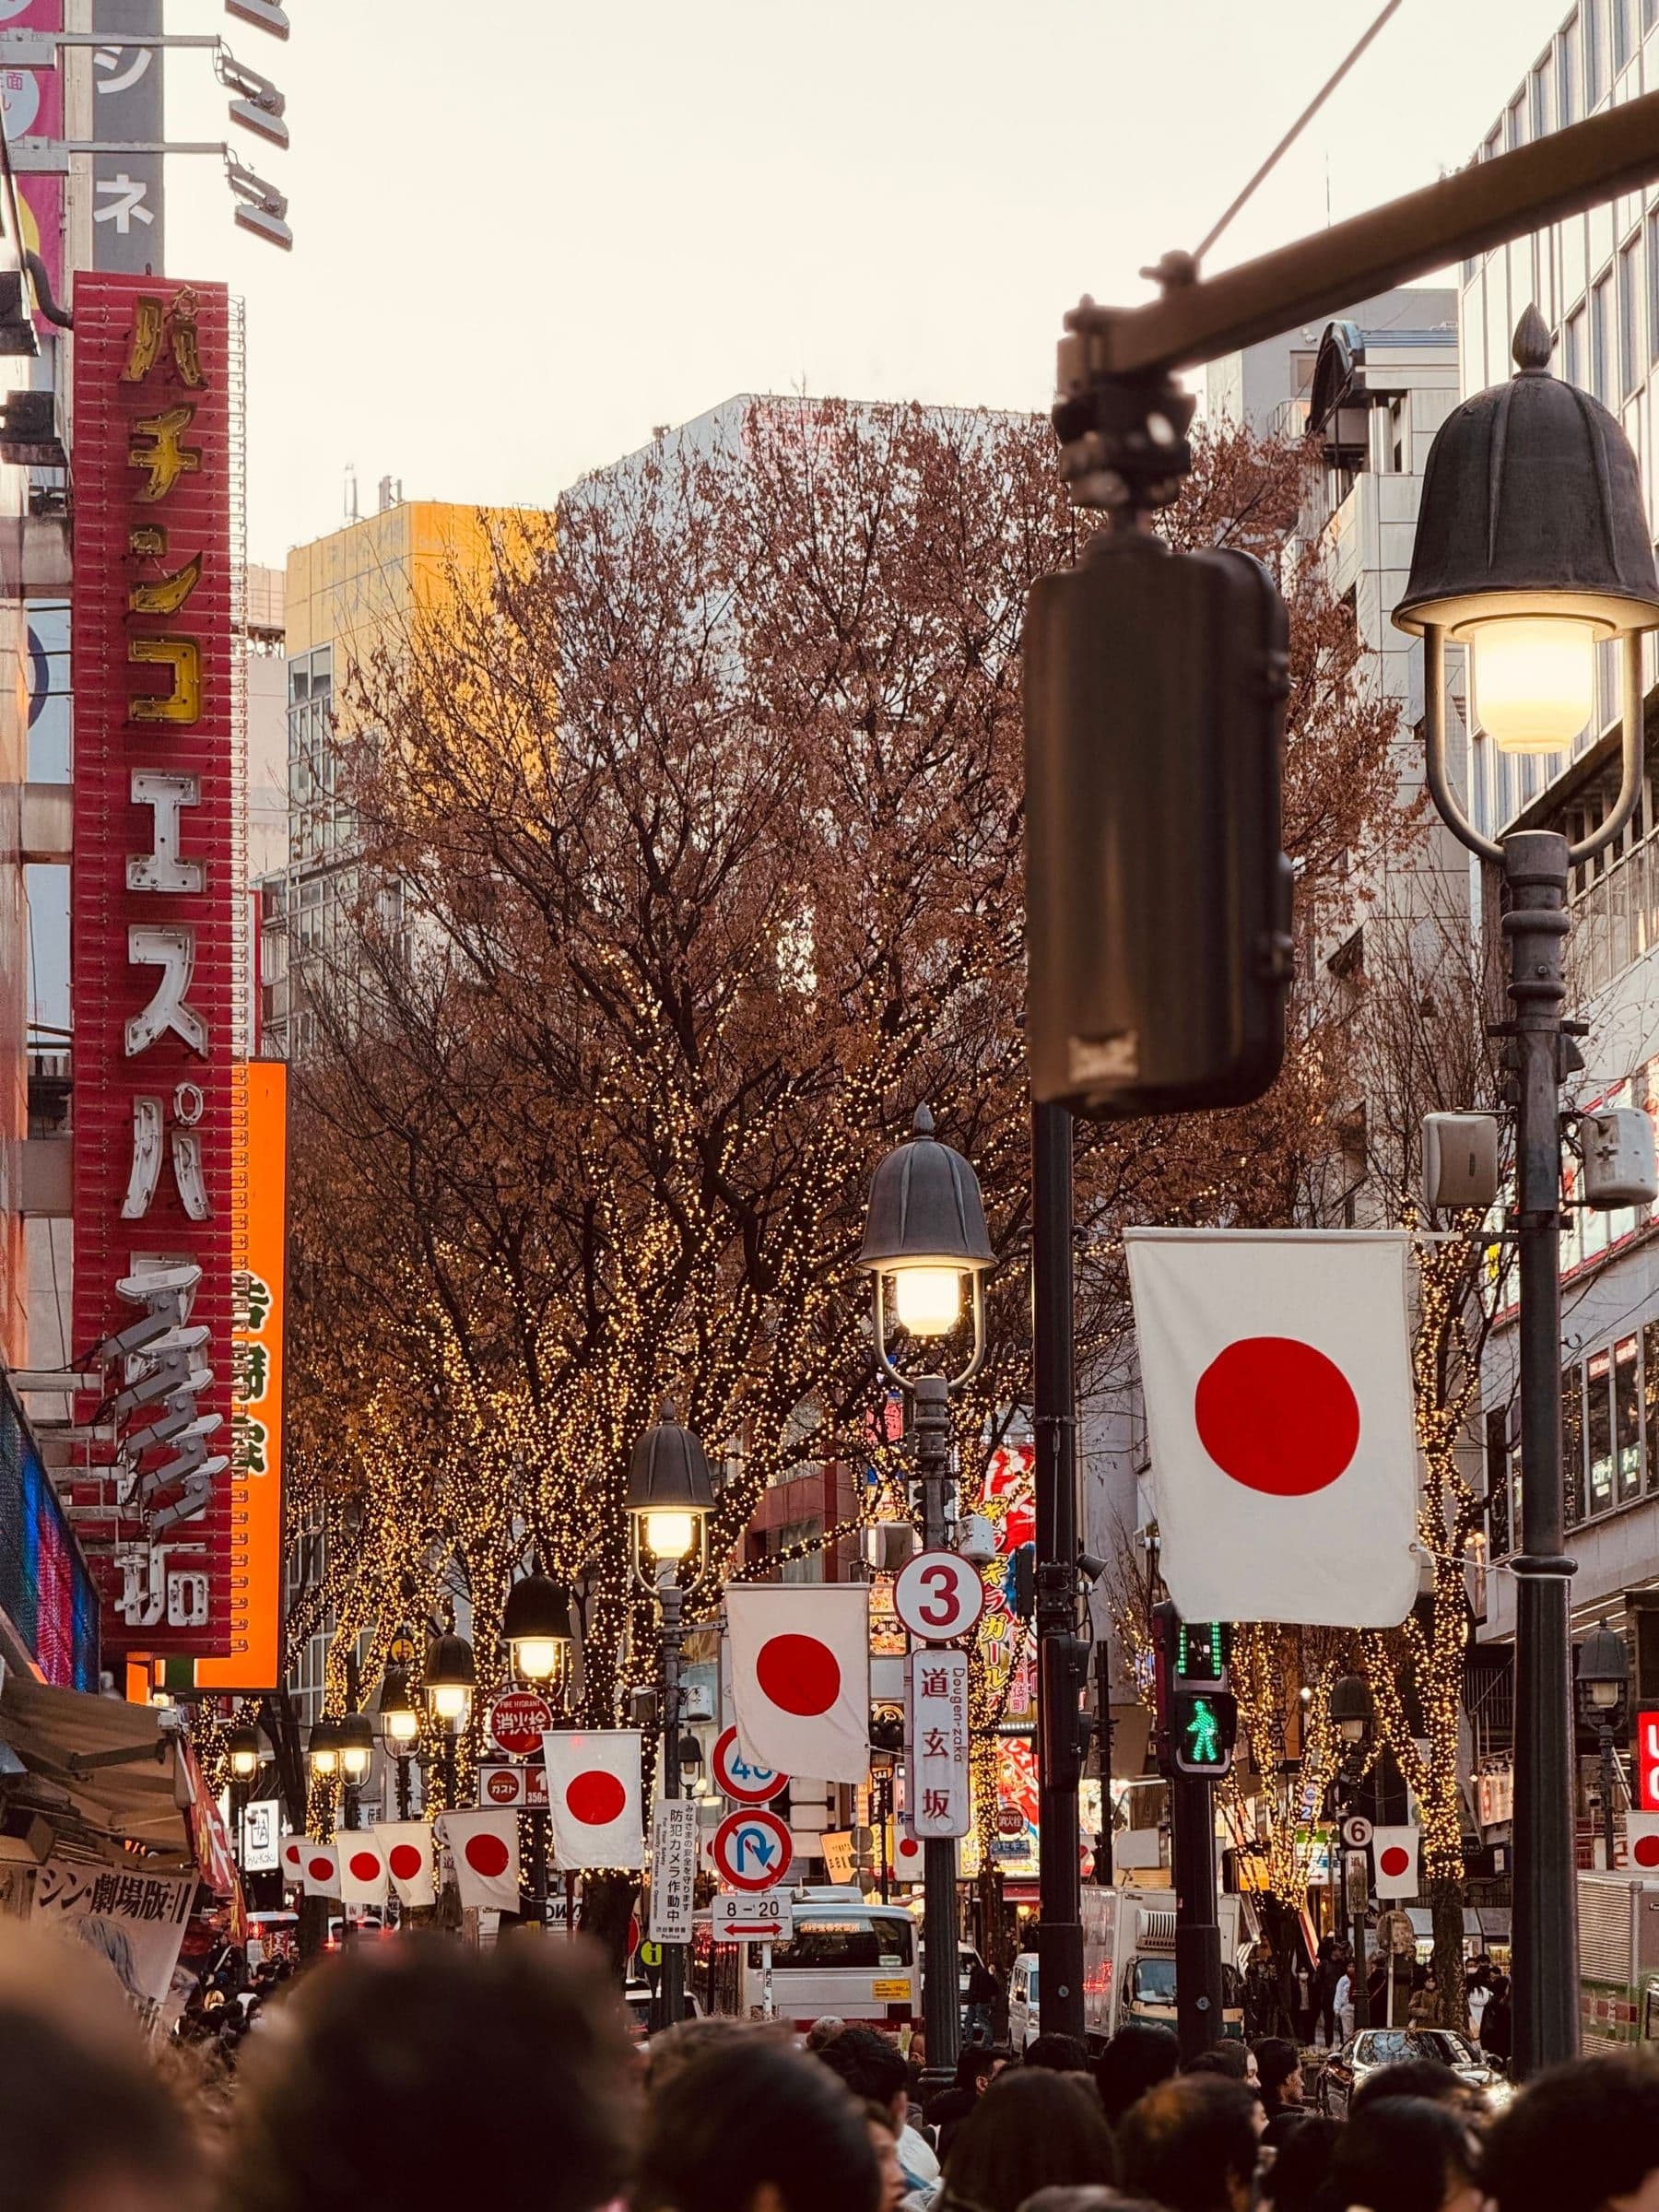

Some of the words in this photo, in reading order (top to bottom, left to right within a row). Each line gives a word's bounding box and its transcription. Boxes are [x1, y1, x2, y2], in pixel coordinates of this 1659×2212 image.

[120, 285, 209, 724] パチンコ
[113, 768, 215, 1627] エスパ拓
[919, 1564, 960, 1627] 3
[496, 1710, 547, 1735] 消火栓
[513, 1700, 540, 1708] HYDRANT
[922, 1667, 950, 1819] 道玄坂
[950, 1667, 967, 1763] Dougen-zaka
[491, 1784, 516, 1794] ガスト
[667, 1808, 684, 1923] 防犯カメラ作動中
[1351, 1820, 1366, 1842] 6
